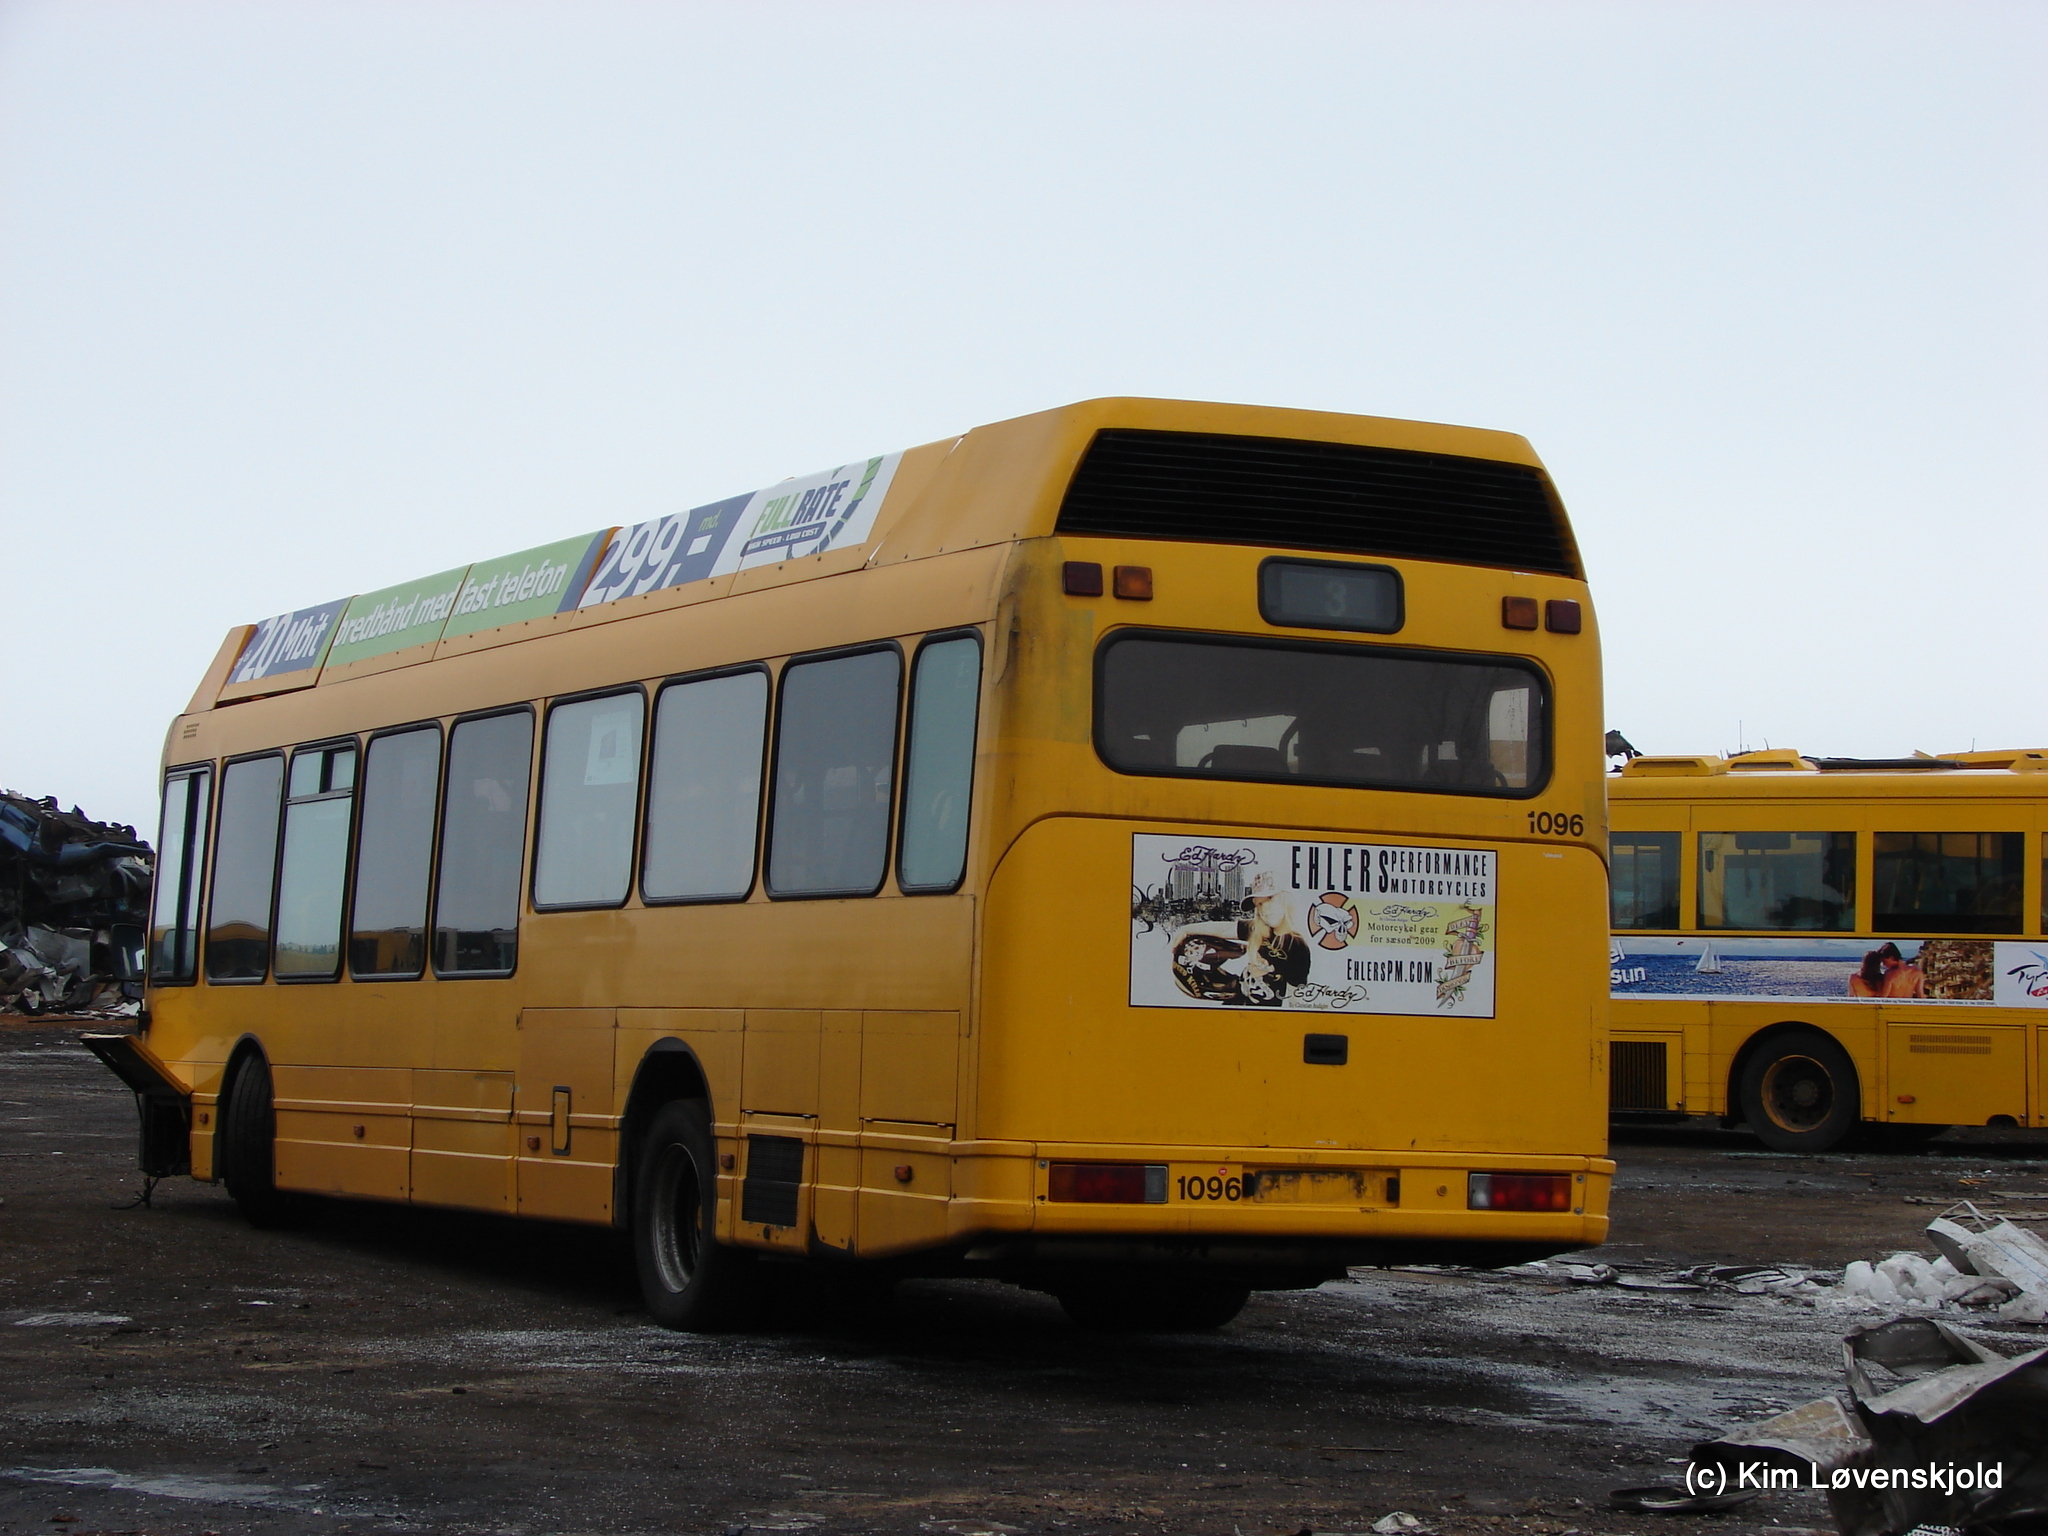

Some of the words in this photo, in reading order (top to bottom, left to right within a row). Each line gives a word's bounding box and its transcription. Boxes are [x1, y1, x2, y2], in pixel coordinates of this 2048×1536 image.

[761, 535, 783, 547] SPEED
[785, 531, 802, 541] LOW
[801, 527, 820, 538] COST
[333, 597, 420, 647] bredbånd
[412, 583, 459, 627] med
[454, 573, 500, 615] fast
[494, 562, 567, 608] telefon
[235, 612, 294, 684] 20
[274, 612, 330, 664] Mbit
[1527, 811, 1584, 837] 1096
[1198, 846, 1254, 872] Hardy
[1291, 846, 1389, 893] EHLERS
[1391, 851, 1487, 877] PERFORMANCE
[1390, 878, 1486, 897] MOTORCYCLES
[1367, 922, 1417, 933] Motorcykel
[1420, 926, 1439, 935] gear
[1370, 935, 1383, 943] for
[1415, 936, 1435, 945] 2009
[2006, 964, 2048, 996] Tyr
[1311, 983, 1365, 1008] Hardy
[1177, 1175, 1242, 1202] 1096
